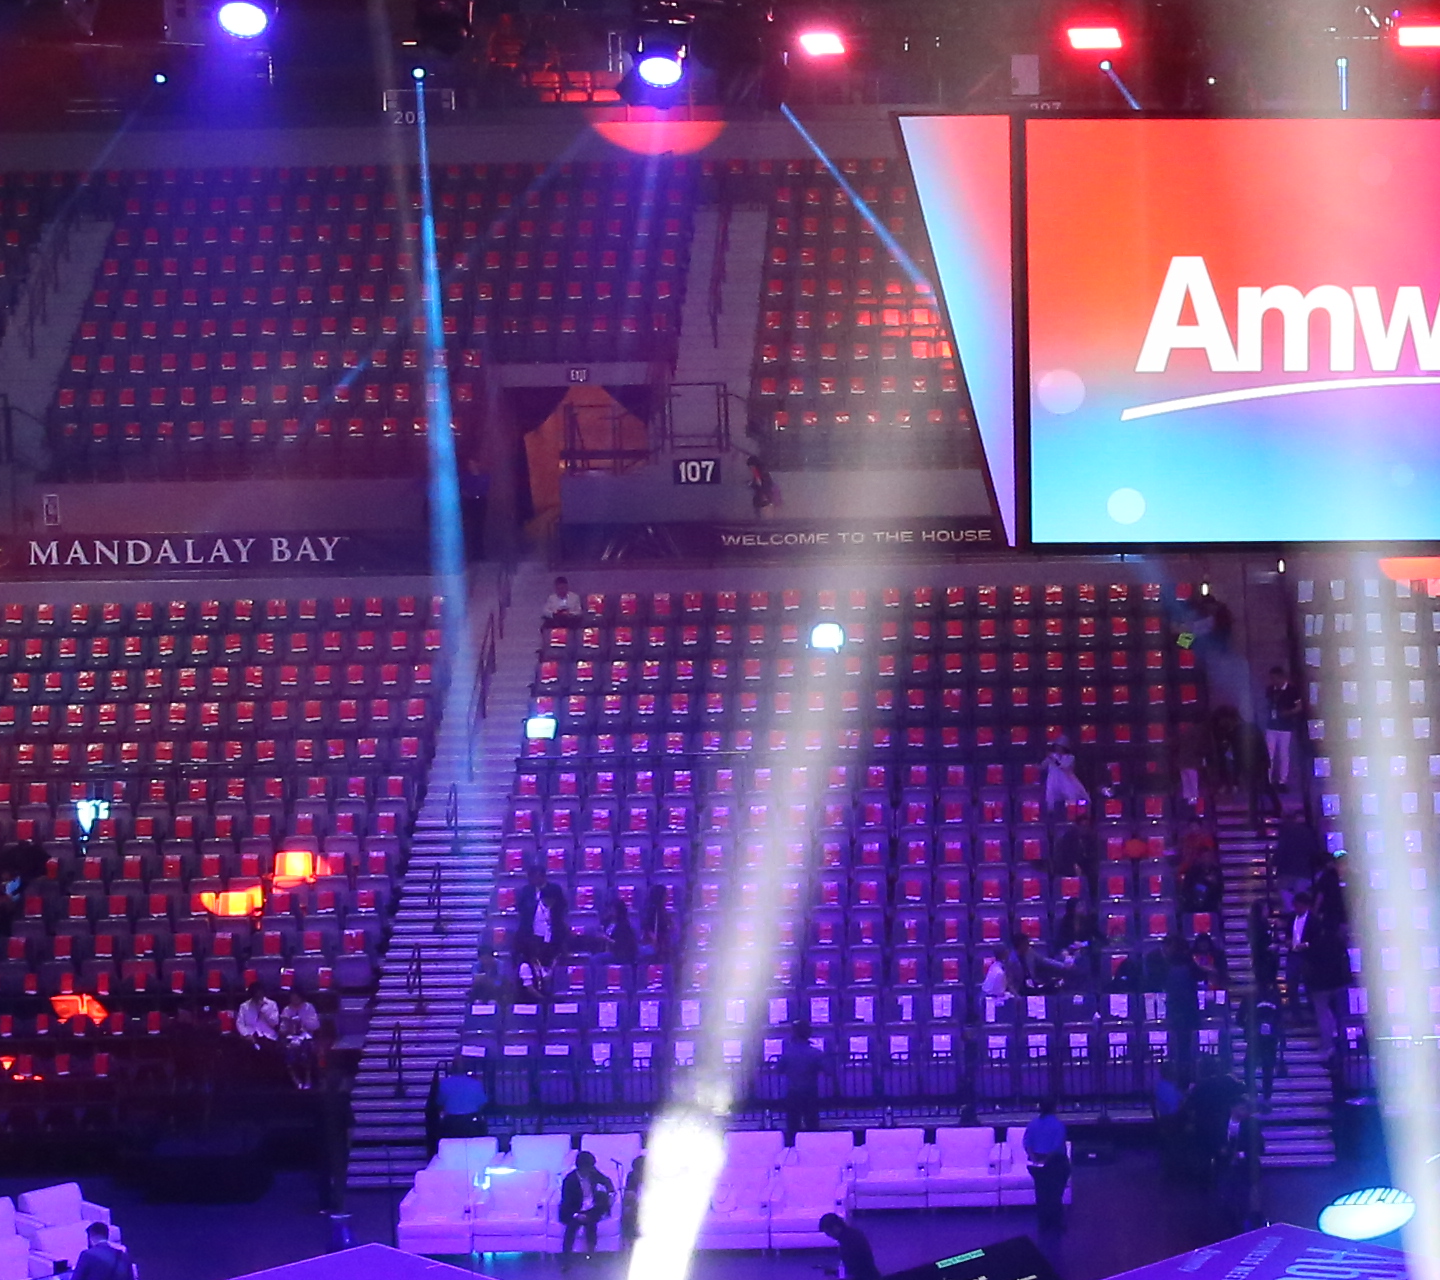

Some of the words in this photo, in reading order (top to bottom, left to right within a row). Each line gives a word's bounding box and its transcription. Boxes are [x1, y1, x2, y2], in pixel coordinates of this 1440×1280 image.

[570, 369, 587, 382] EXIT
[679, 460, 715, 483] 107
[721, 532, 829, 546] WELCOME
[838, 532, 865, 543] TO
[872, 530, 914, 543] THE
[921, 529, 993, 542] HOUSE
[28, 537, 257, 566] MANDALAY
[269, 536, 341, 562] BAY
